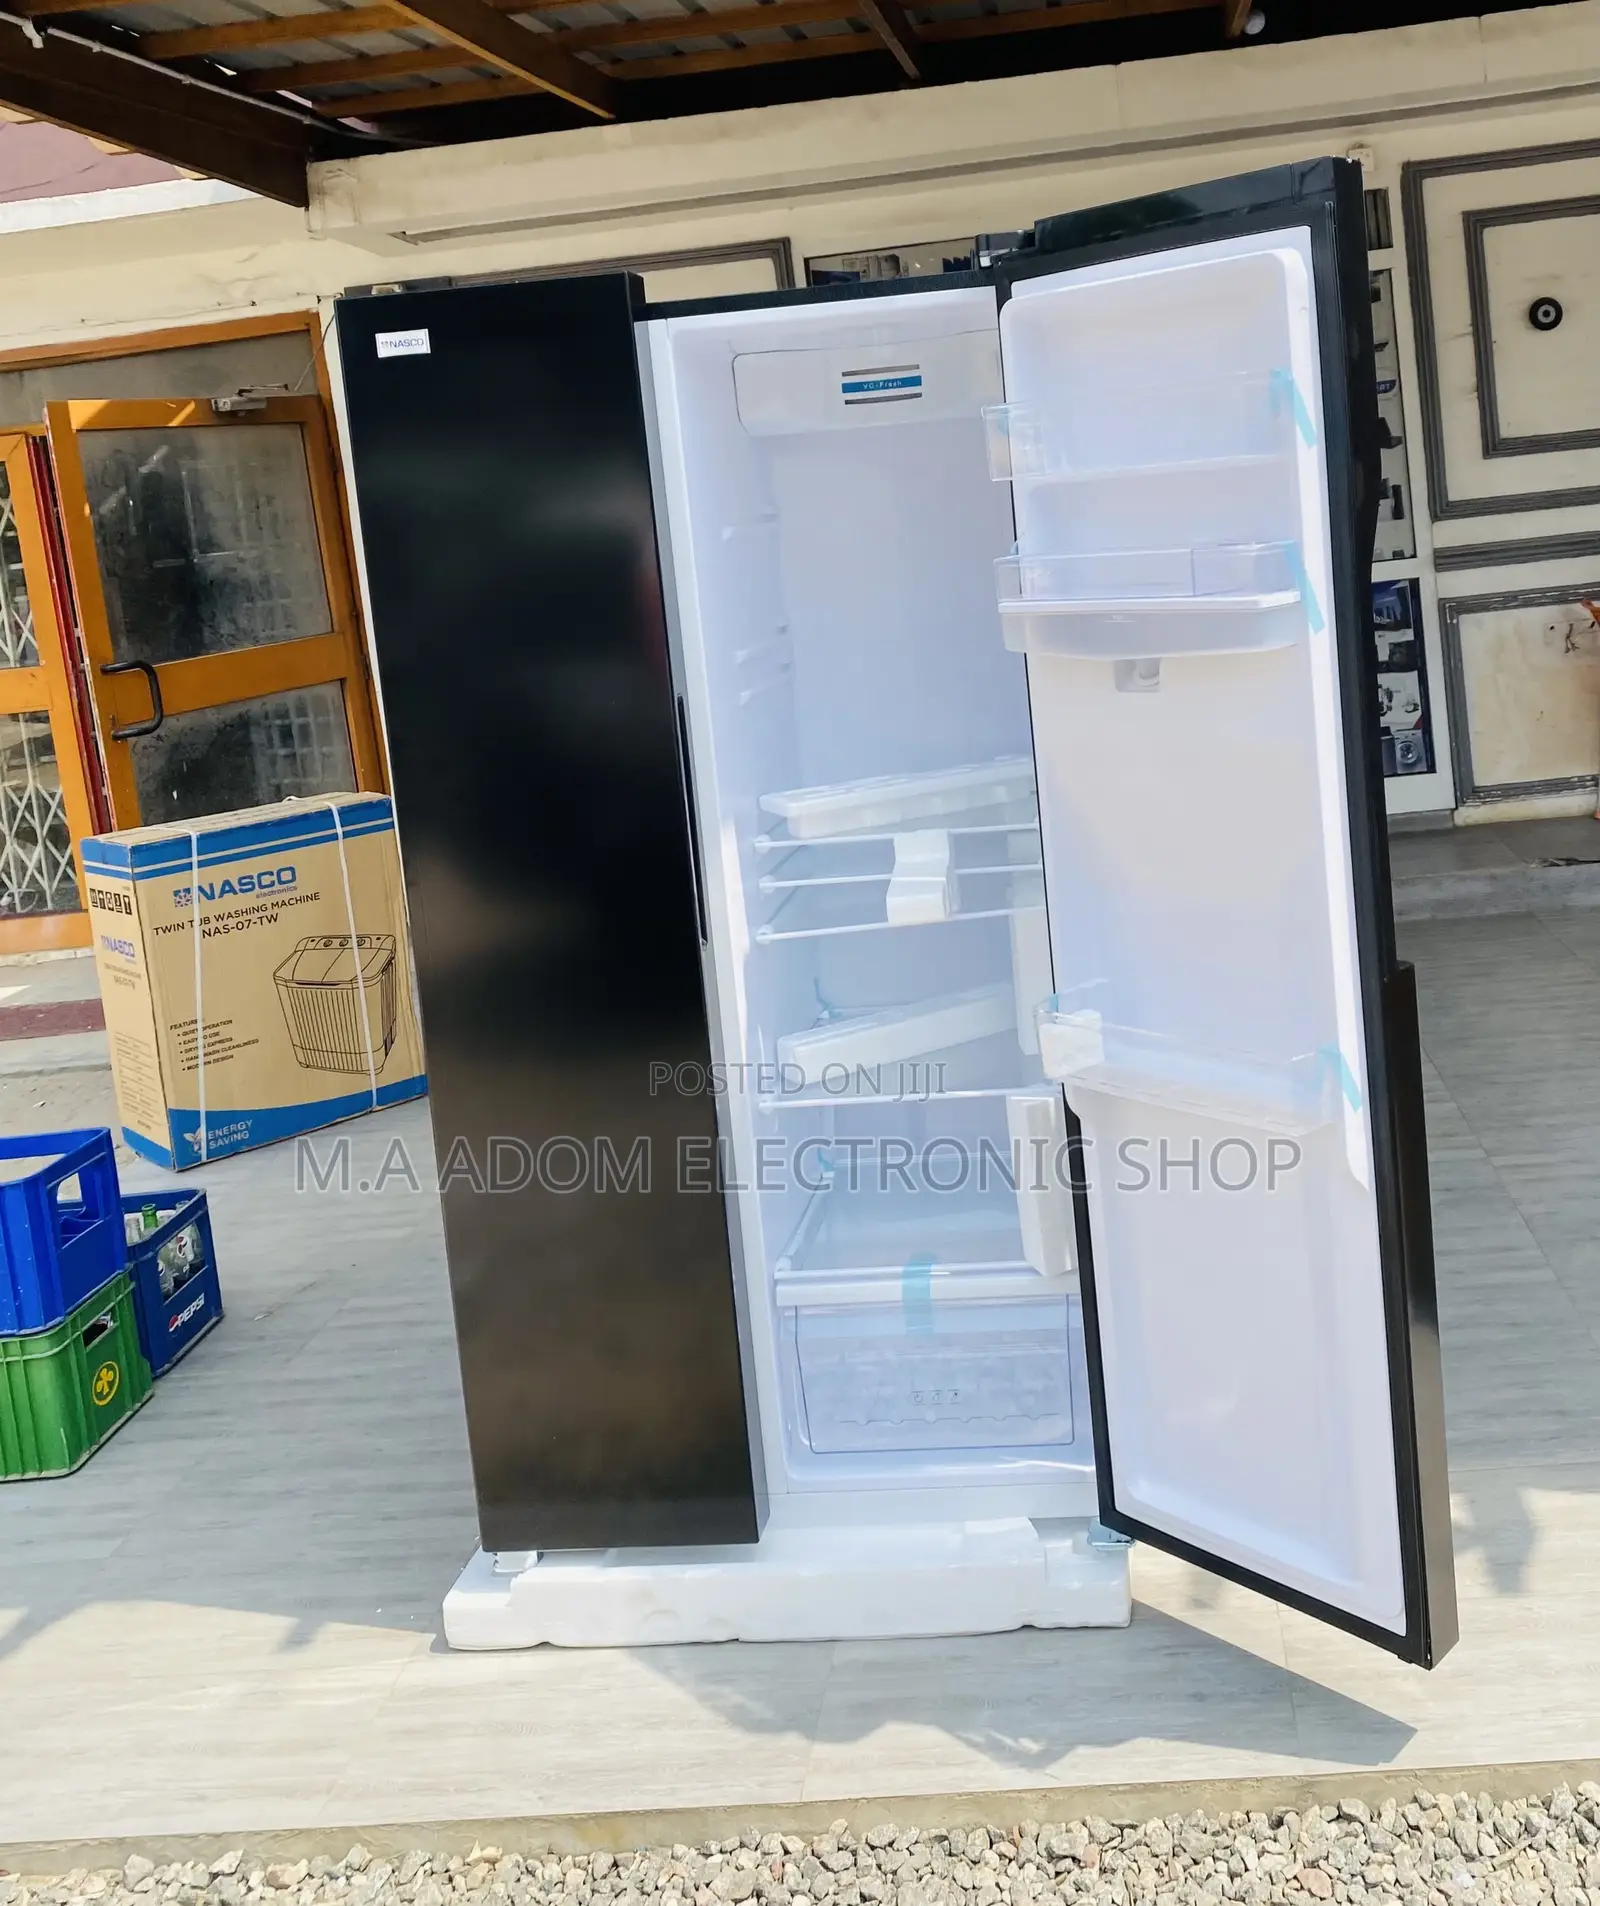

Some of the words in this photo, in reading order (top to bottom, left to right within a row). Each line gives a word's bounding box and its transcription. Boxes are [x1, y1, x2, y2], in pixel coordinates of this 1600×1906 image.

[390, 338, 424, 348] NASCO
[197, 866, 297, 903] NASCO
[255, 885, 298, 899] electronics
[153, 921, 185, 936] TWIN
[213, 903, 268, 922] WASHING
[271, 891, 321, 911] MACHINE
[202, 913, 279, 939] NAS-07-TW
[207, 1036, 233, 1048] EXPRESS
[208, 1031, 220, 1039] USE
[212, 1054, 234, 1064] DESIGN
[207, 1119, 253, 1140] ENERGY
[208, 1130, 250, 1150] SAVING
[177, 1292, 205, 1327] PEPSI
